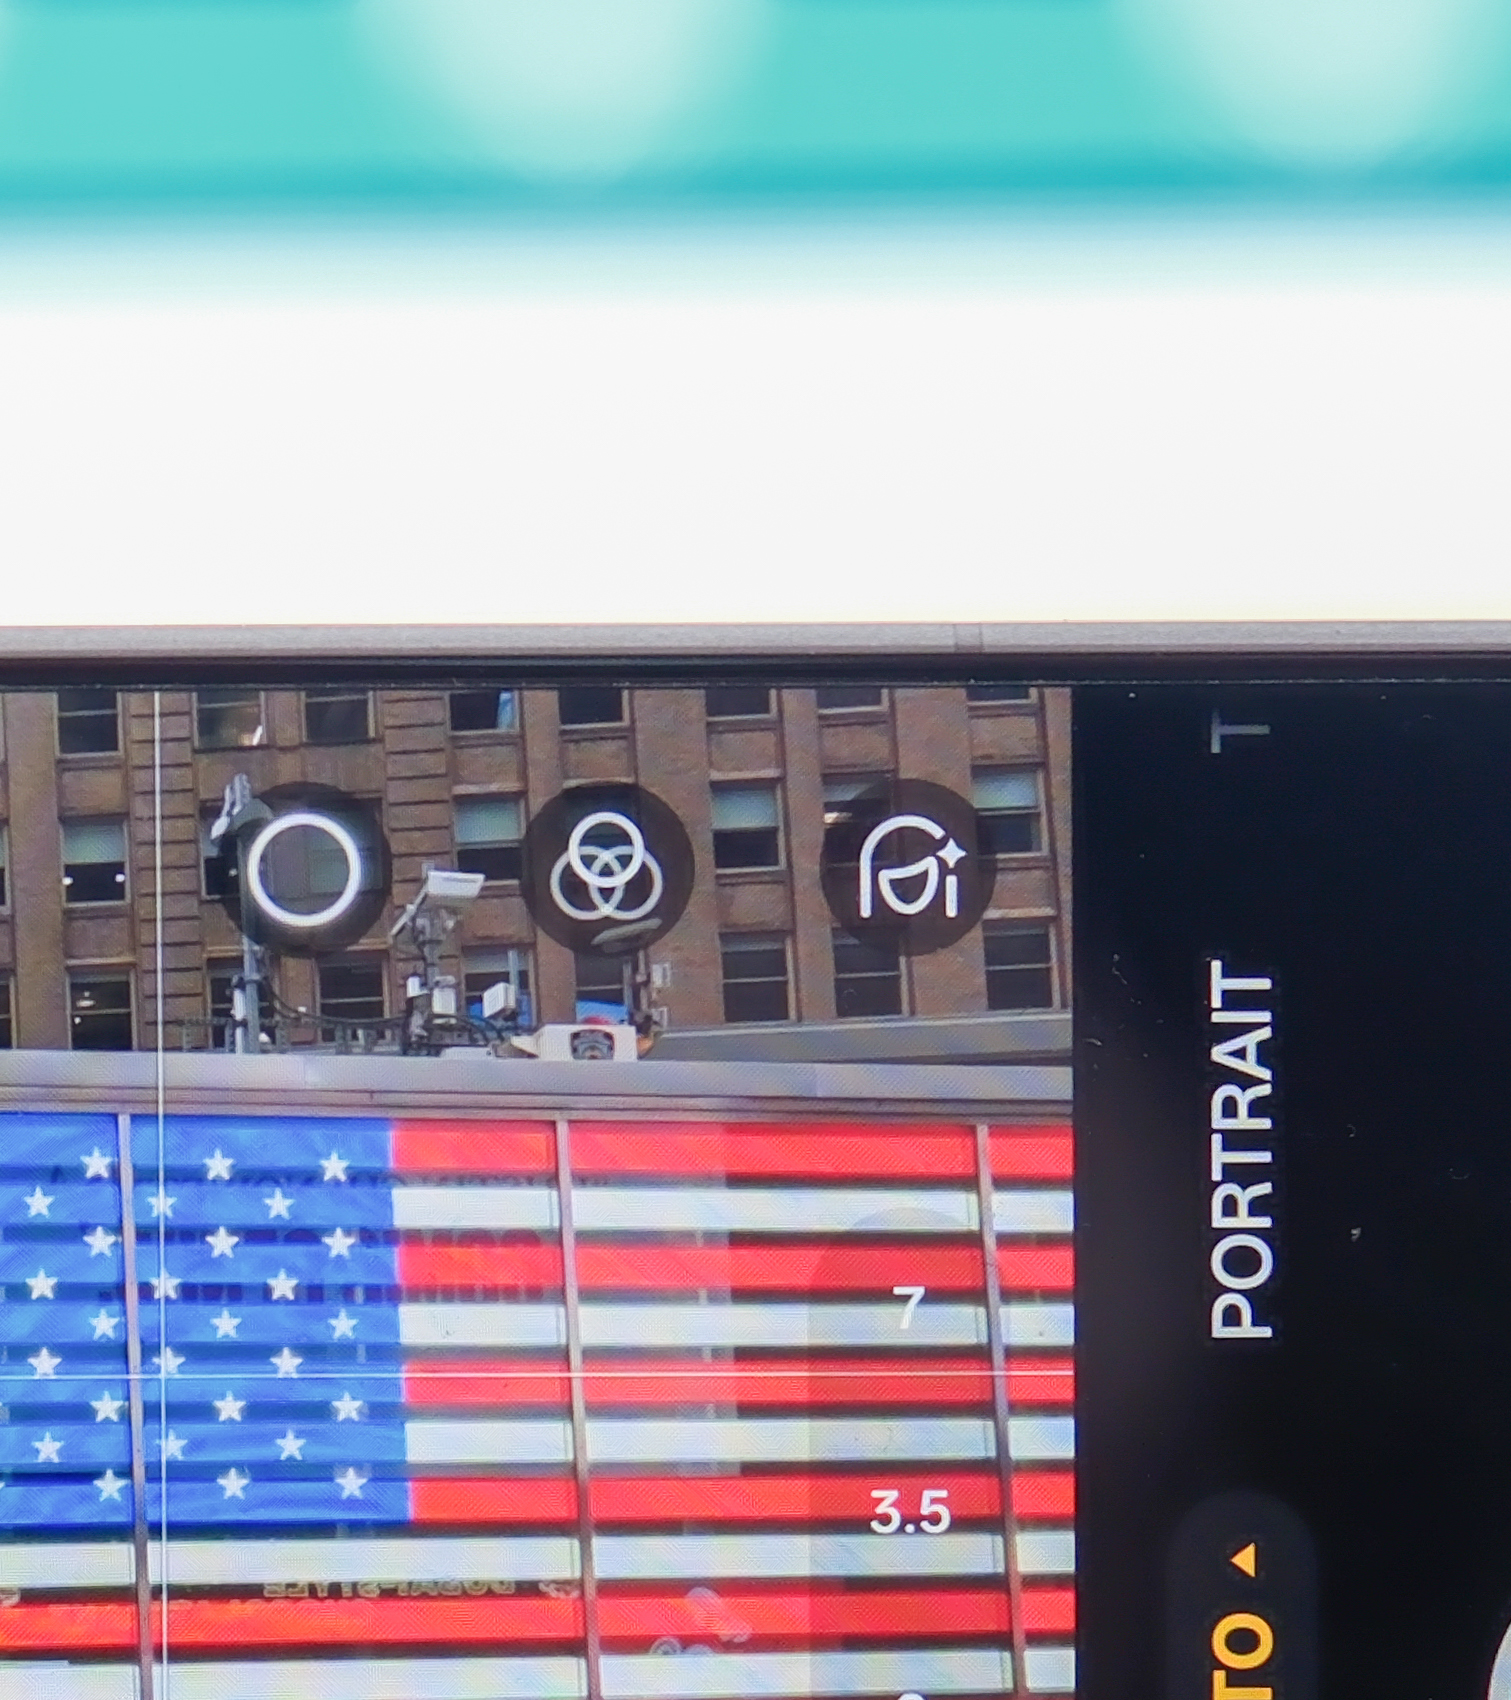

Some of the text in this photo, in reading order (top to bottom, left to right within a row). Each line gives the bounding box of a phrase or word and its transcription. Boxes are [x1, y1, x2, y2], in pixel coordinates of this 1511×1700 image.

[1211, 707, 1271, 753] T
[1211, 959, 1274, 1339] PORTRAIT
[892, 1285, 926, 1329] 7
[870, 1489, 952, 1534] 3.5
